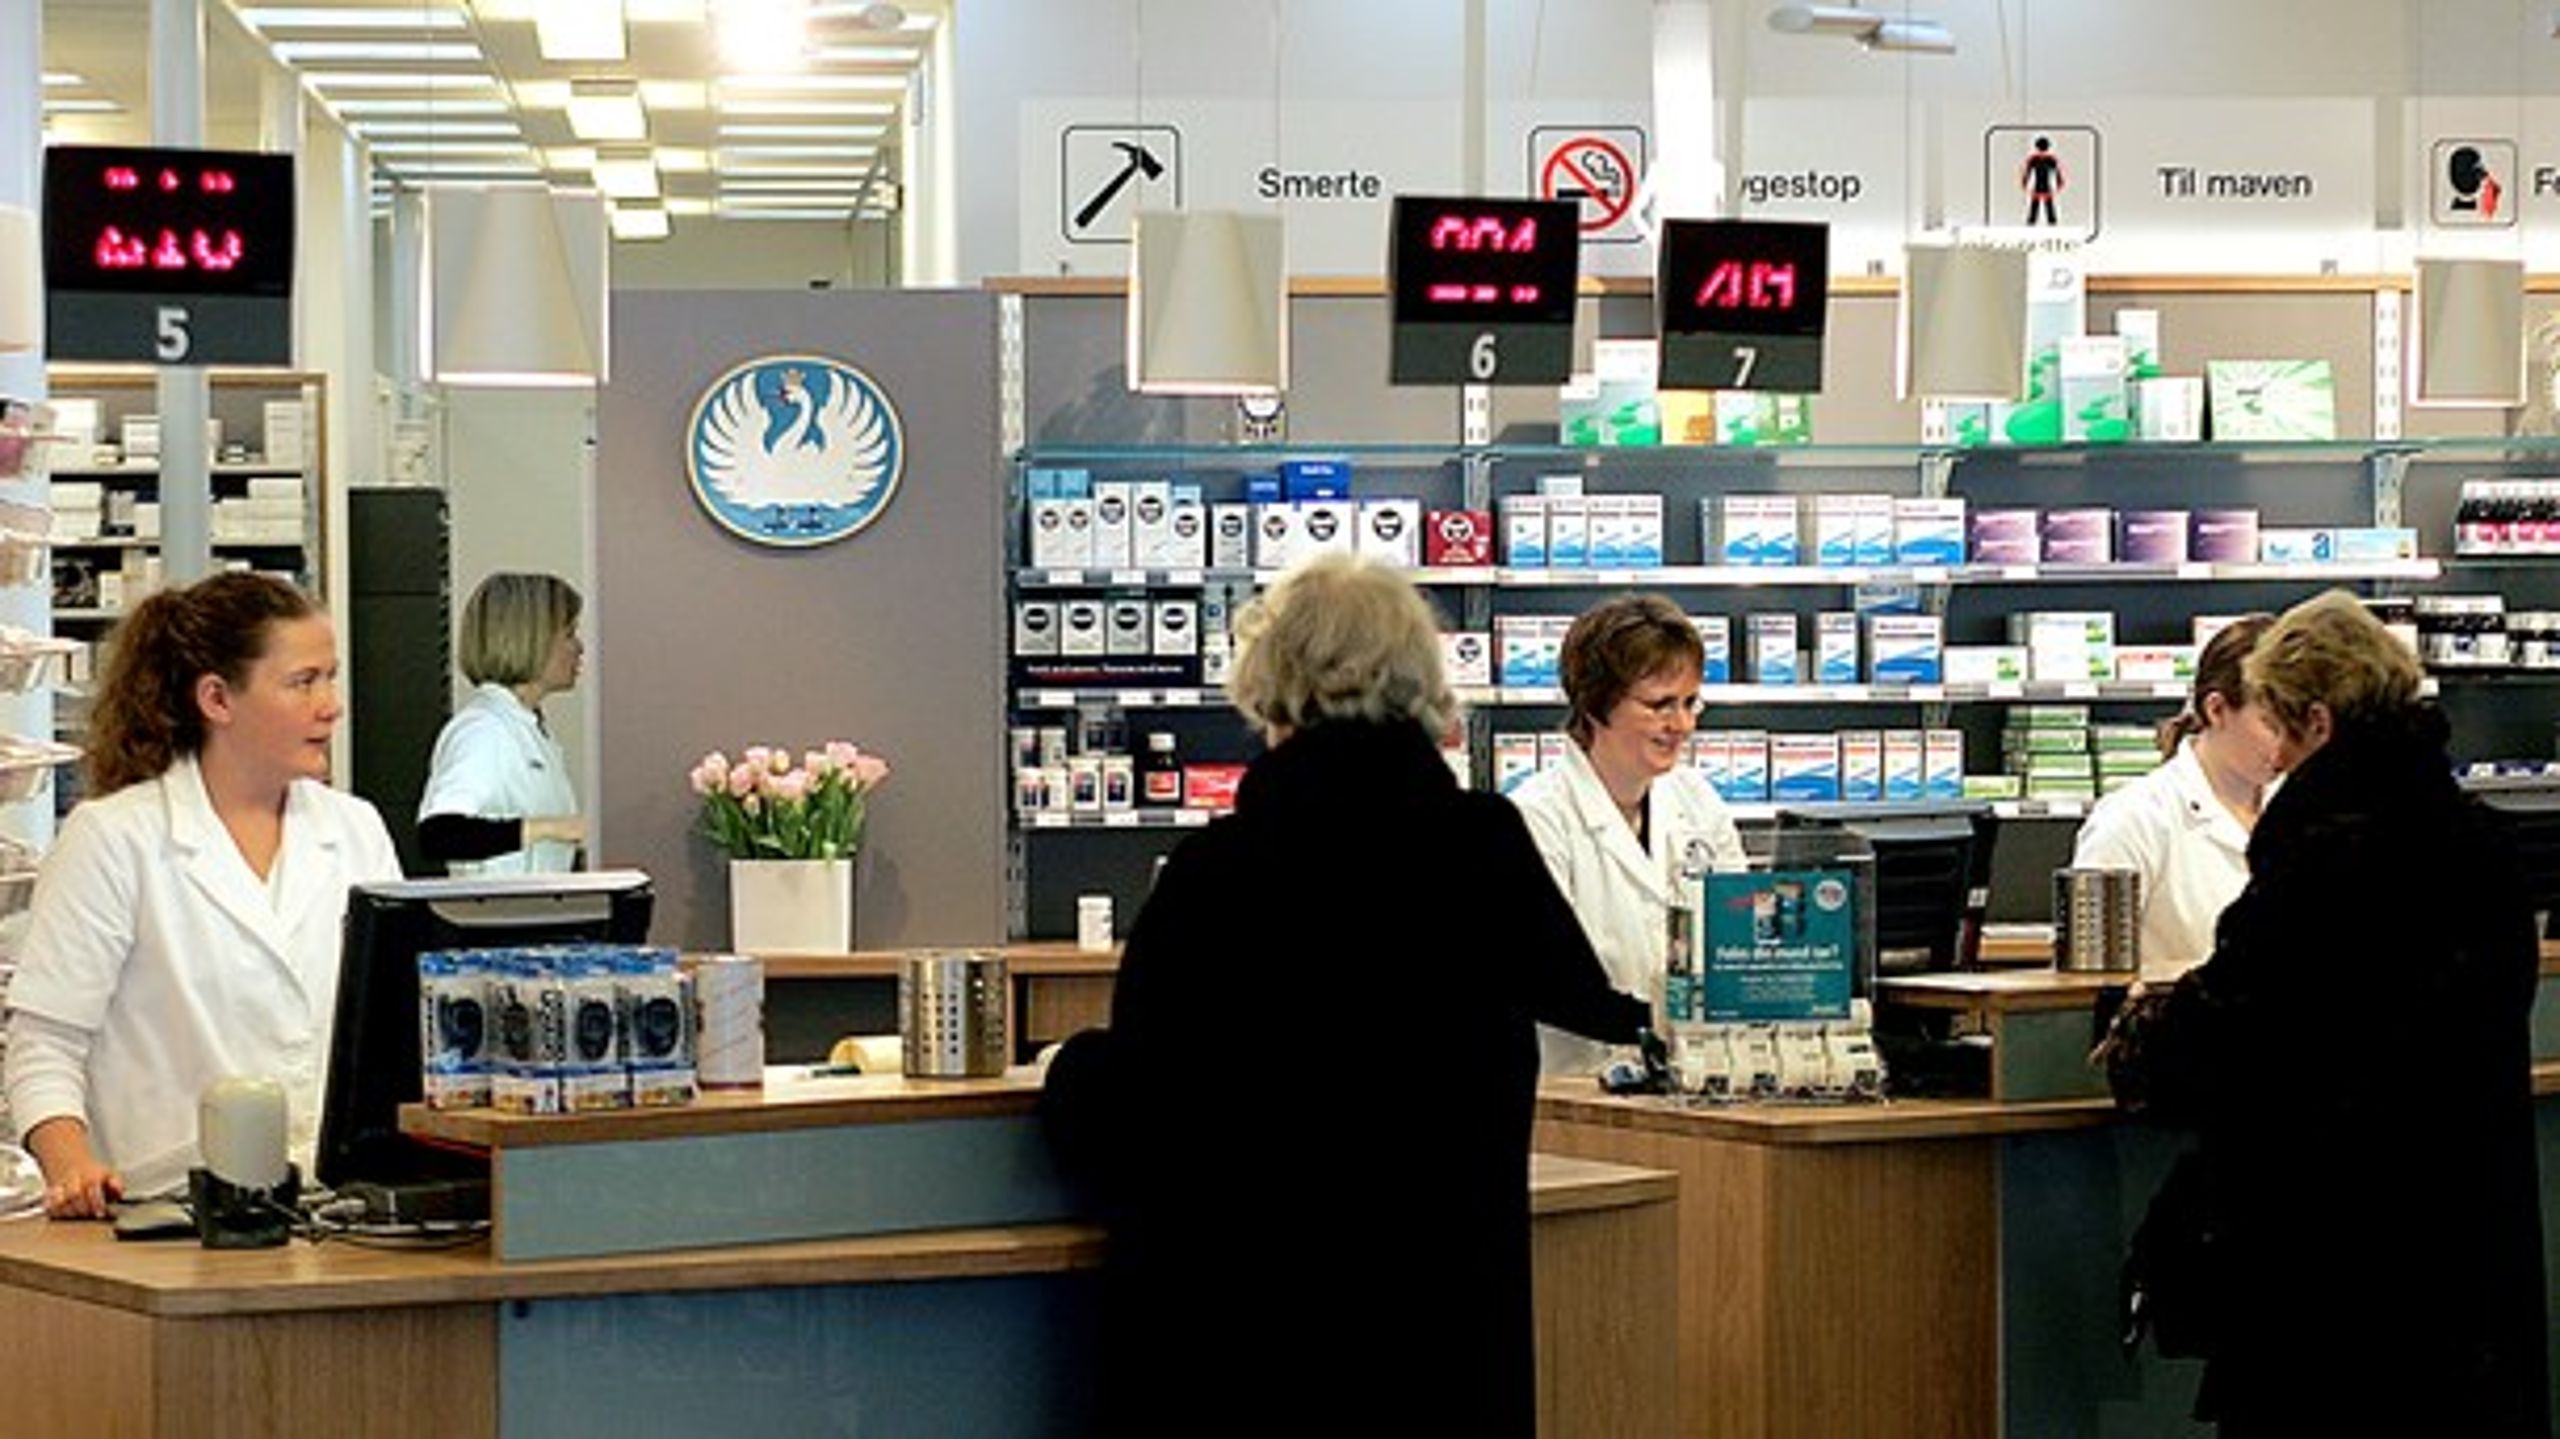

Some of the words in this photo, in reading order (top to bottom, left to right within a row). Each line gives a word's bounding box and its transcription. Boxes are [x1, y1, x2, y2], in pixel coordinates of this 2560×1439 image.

[1257, 168, 1382, 197] Smerte
[2158, 168, 2197, 197] Til
[2207, 174, 2313, 198] maven
[157, 307, 190, 361] 5
[1471, 333, 1496, 379] 6
[1733, 347, 1756, 387] 7
